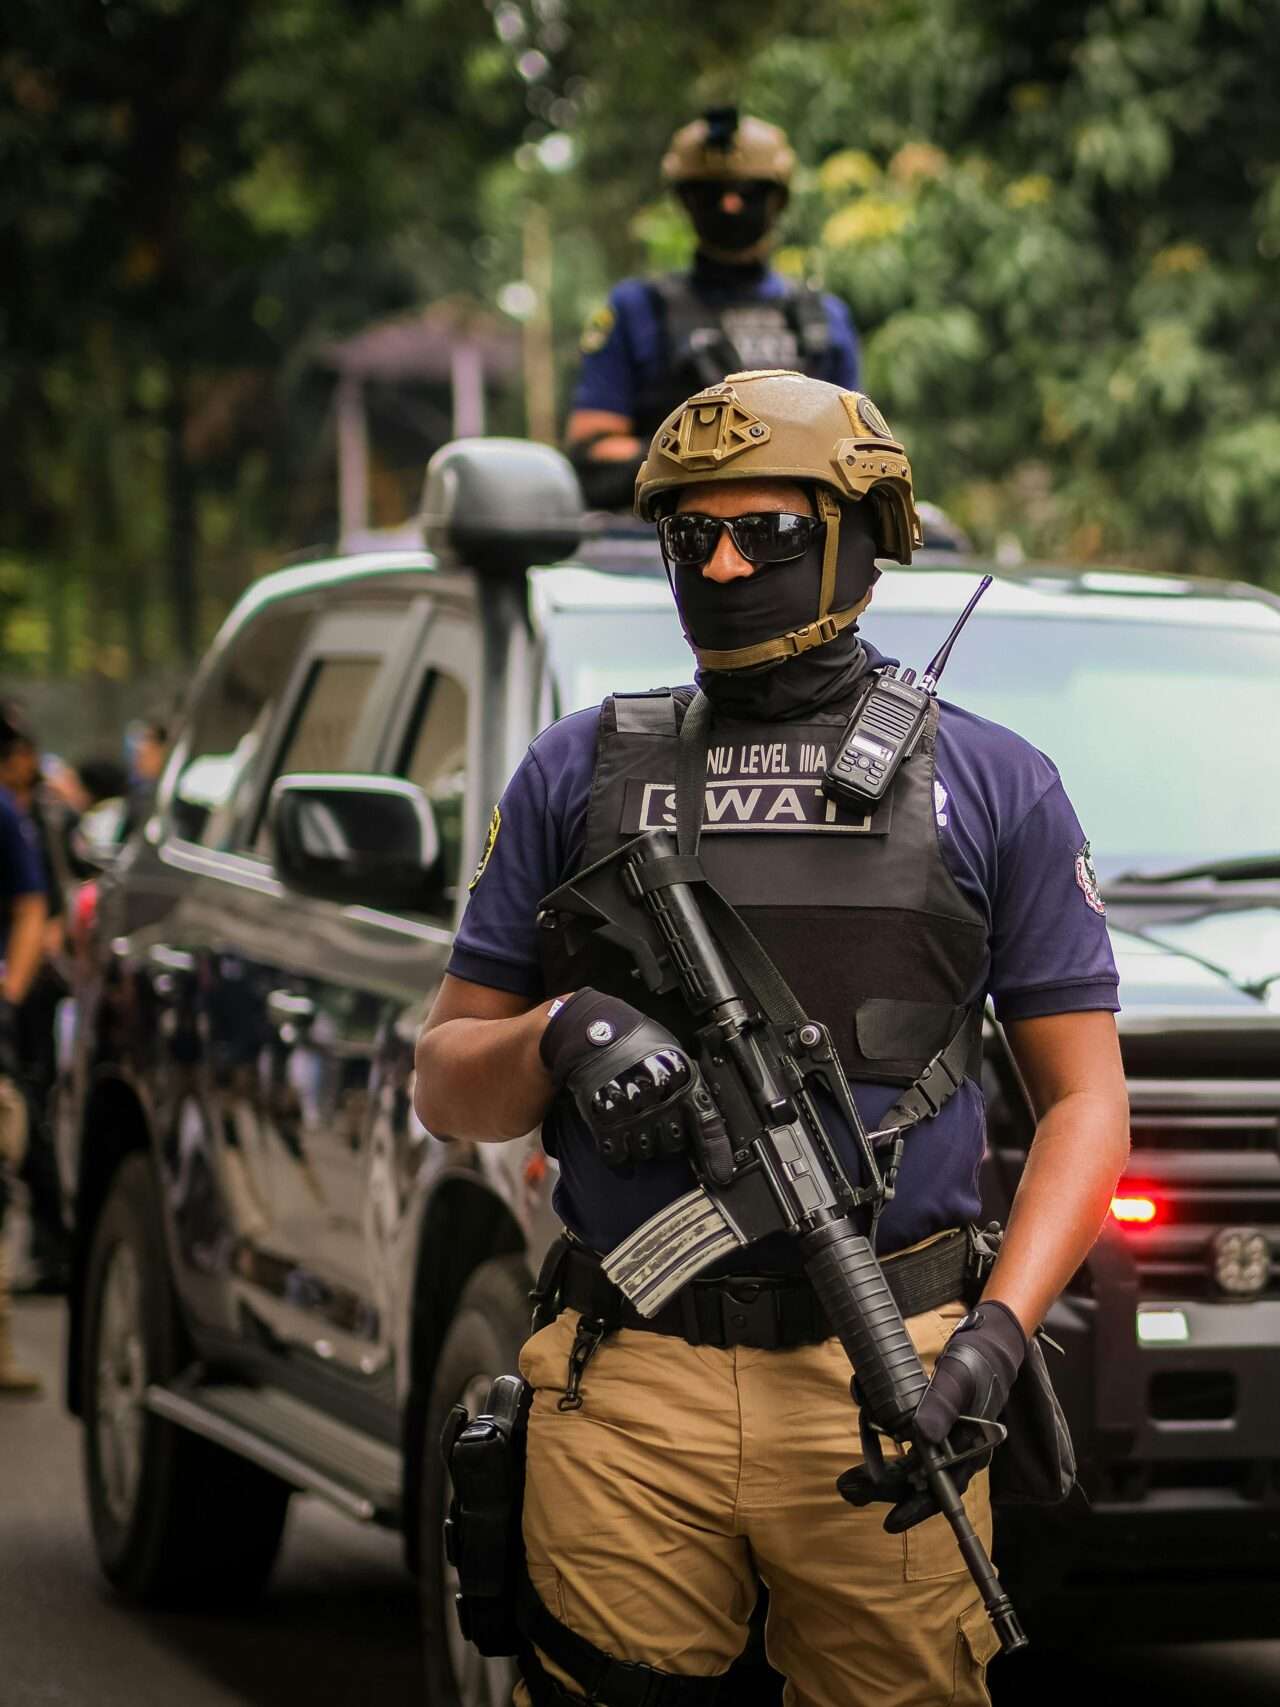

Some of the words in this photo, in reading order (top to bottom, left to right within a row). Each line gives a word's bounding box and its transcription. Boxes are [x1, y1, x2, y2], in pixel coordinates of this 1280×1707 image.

[706, 746, 733, 775] NIJ
[740, 743, 790, 773] LEVEL
[799, 745, 827, 772] IIIA
